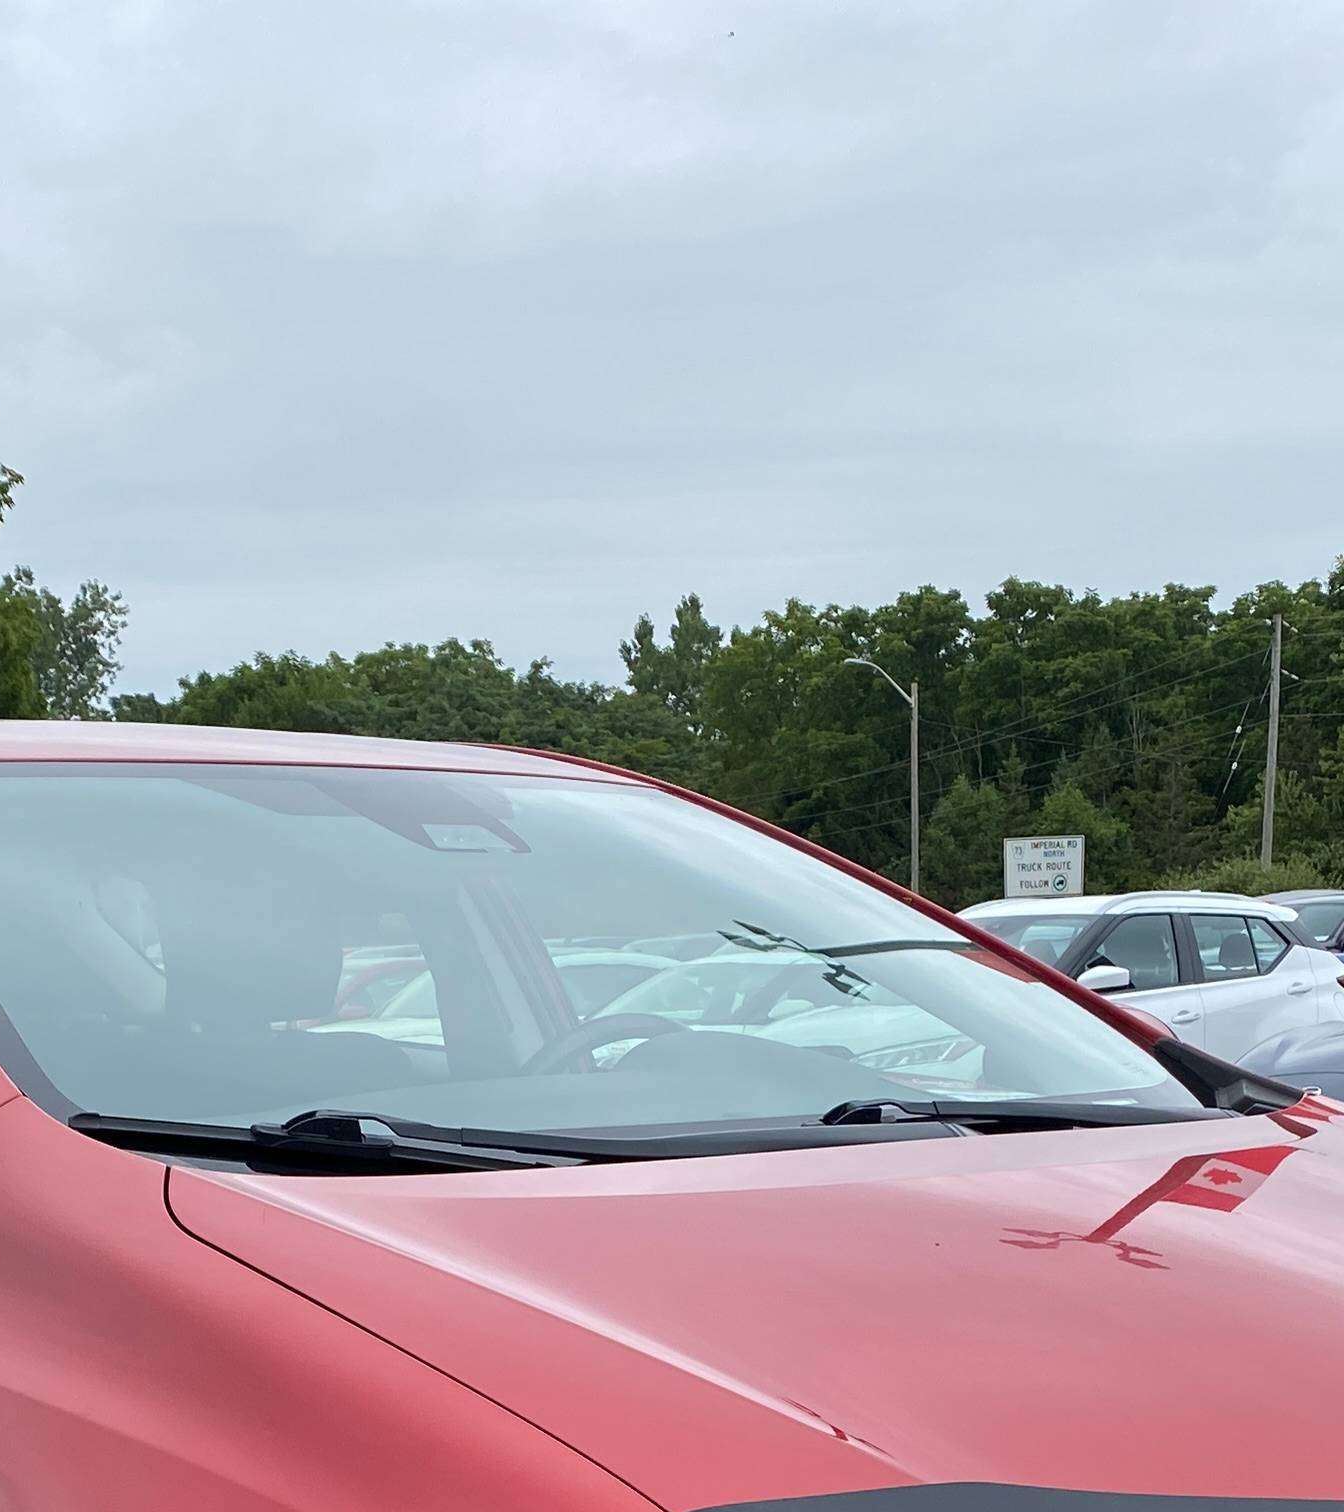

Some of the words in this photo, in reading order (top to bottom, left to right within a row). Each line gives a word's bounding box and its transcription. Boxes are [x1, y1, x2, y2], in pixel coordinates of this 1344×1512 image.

[1030, 841, 1066, 849] IMPERIAL
[1067, 840, 1078, 849] RD
[1017, 862, 1043, 872] TRUCK
[1046, 861, 1072, 871] ROUTE
[1020, 880, 1050, 889] FOLLOW
